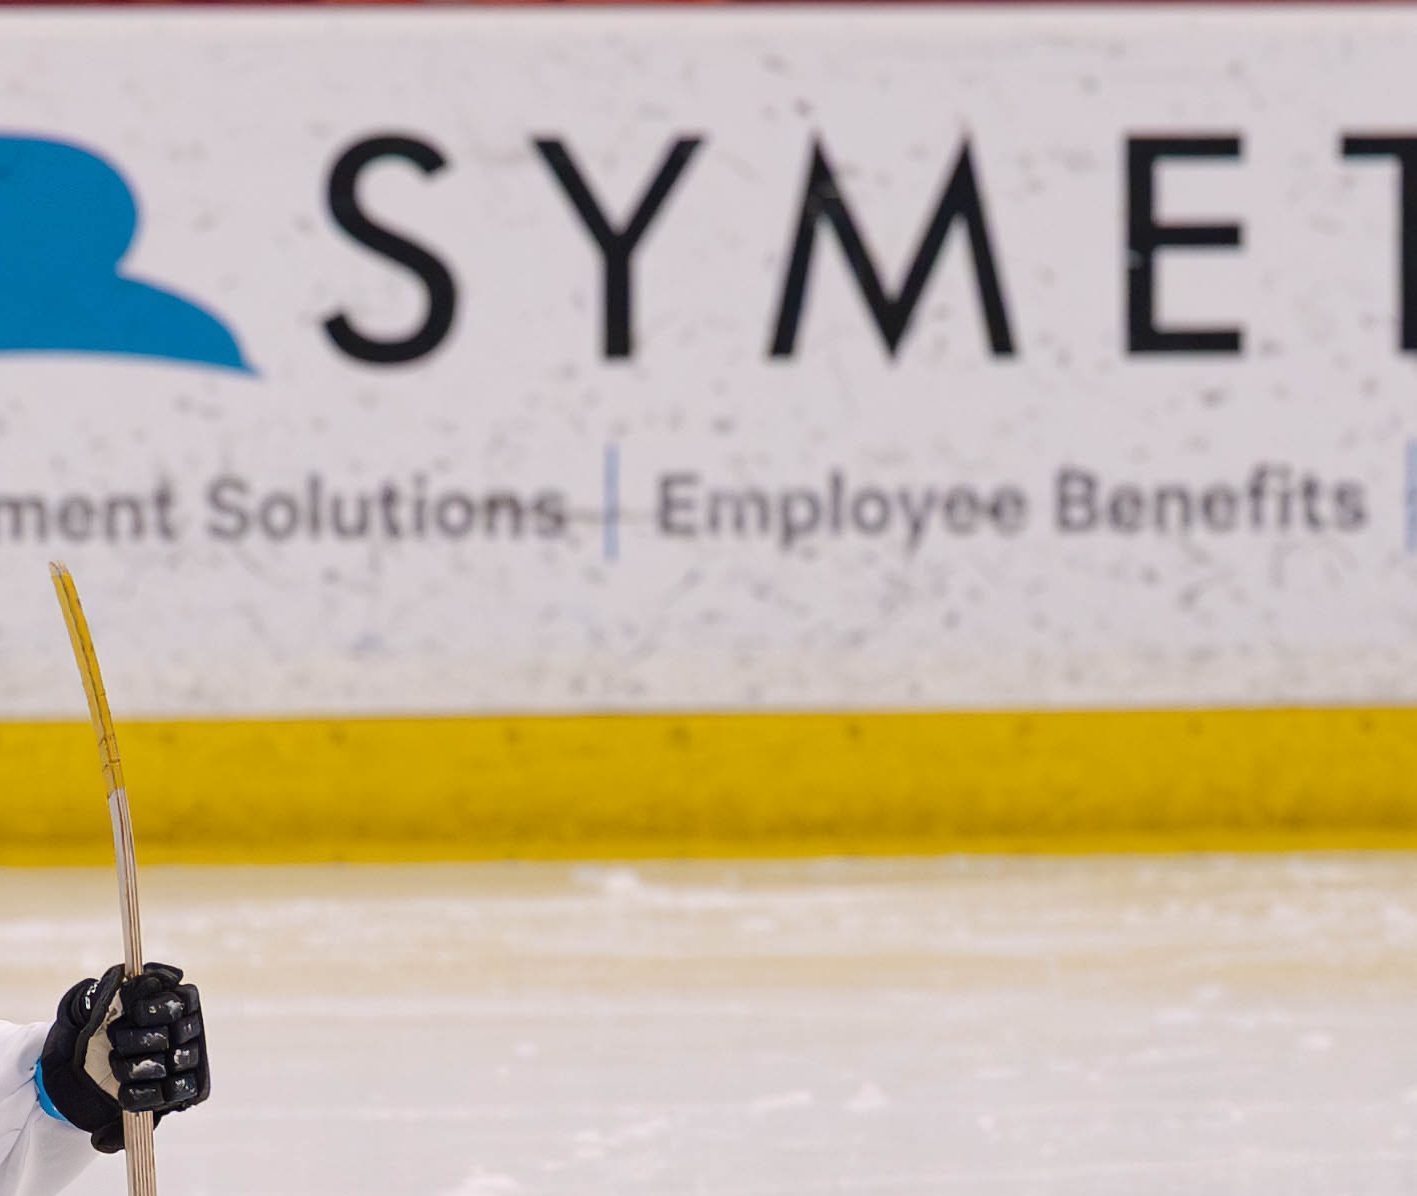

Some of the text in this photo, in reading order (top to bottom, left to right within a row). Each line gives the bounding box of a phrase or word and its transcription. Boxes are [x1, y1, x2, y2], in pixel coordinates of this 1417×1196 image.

[205, 474, 567, 542] Solutions
[654, 464, 1369, 553] Employee Benefits
